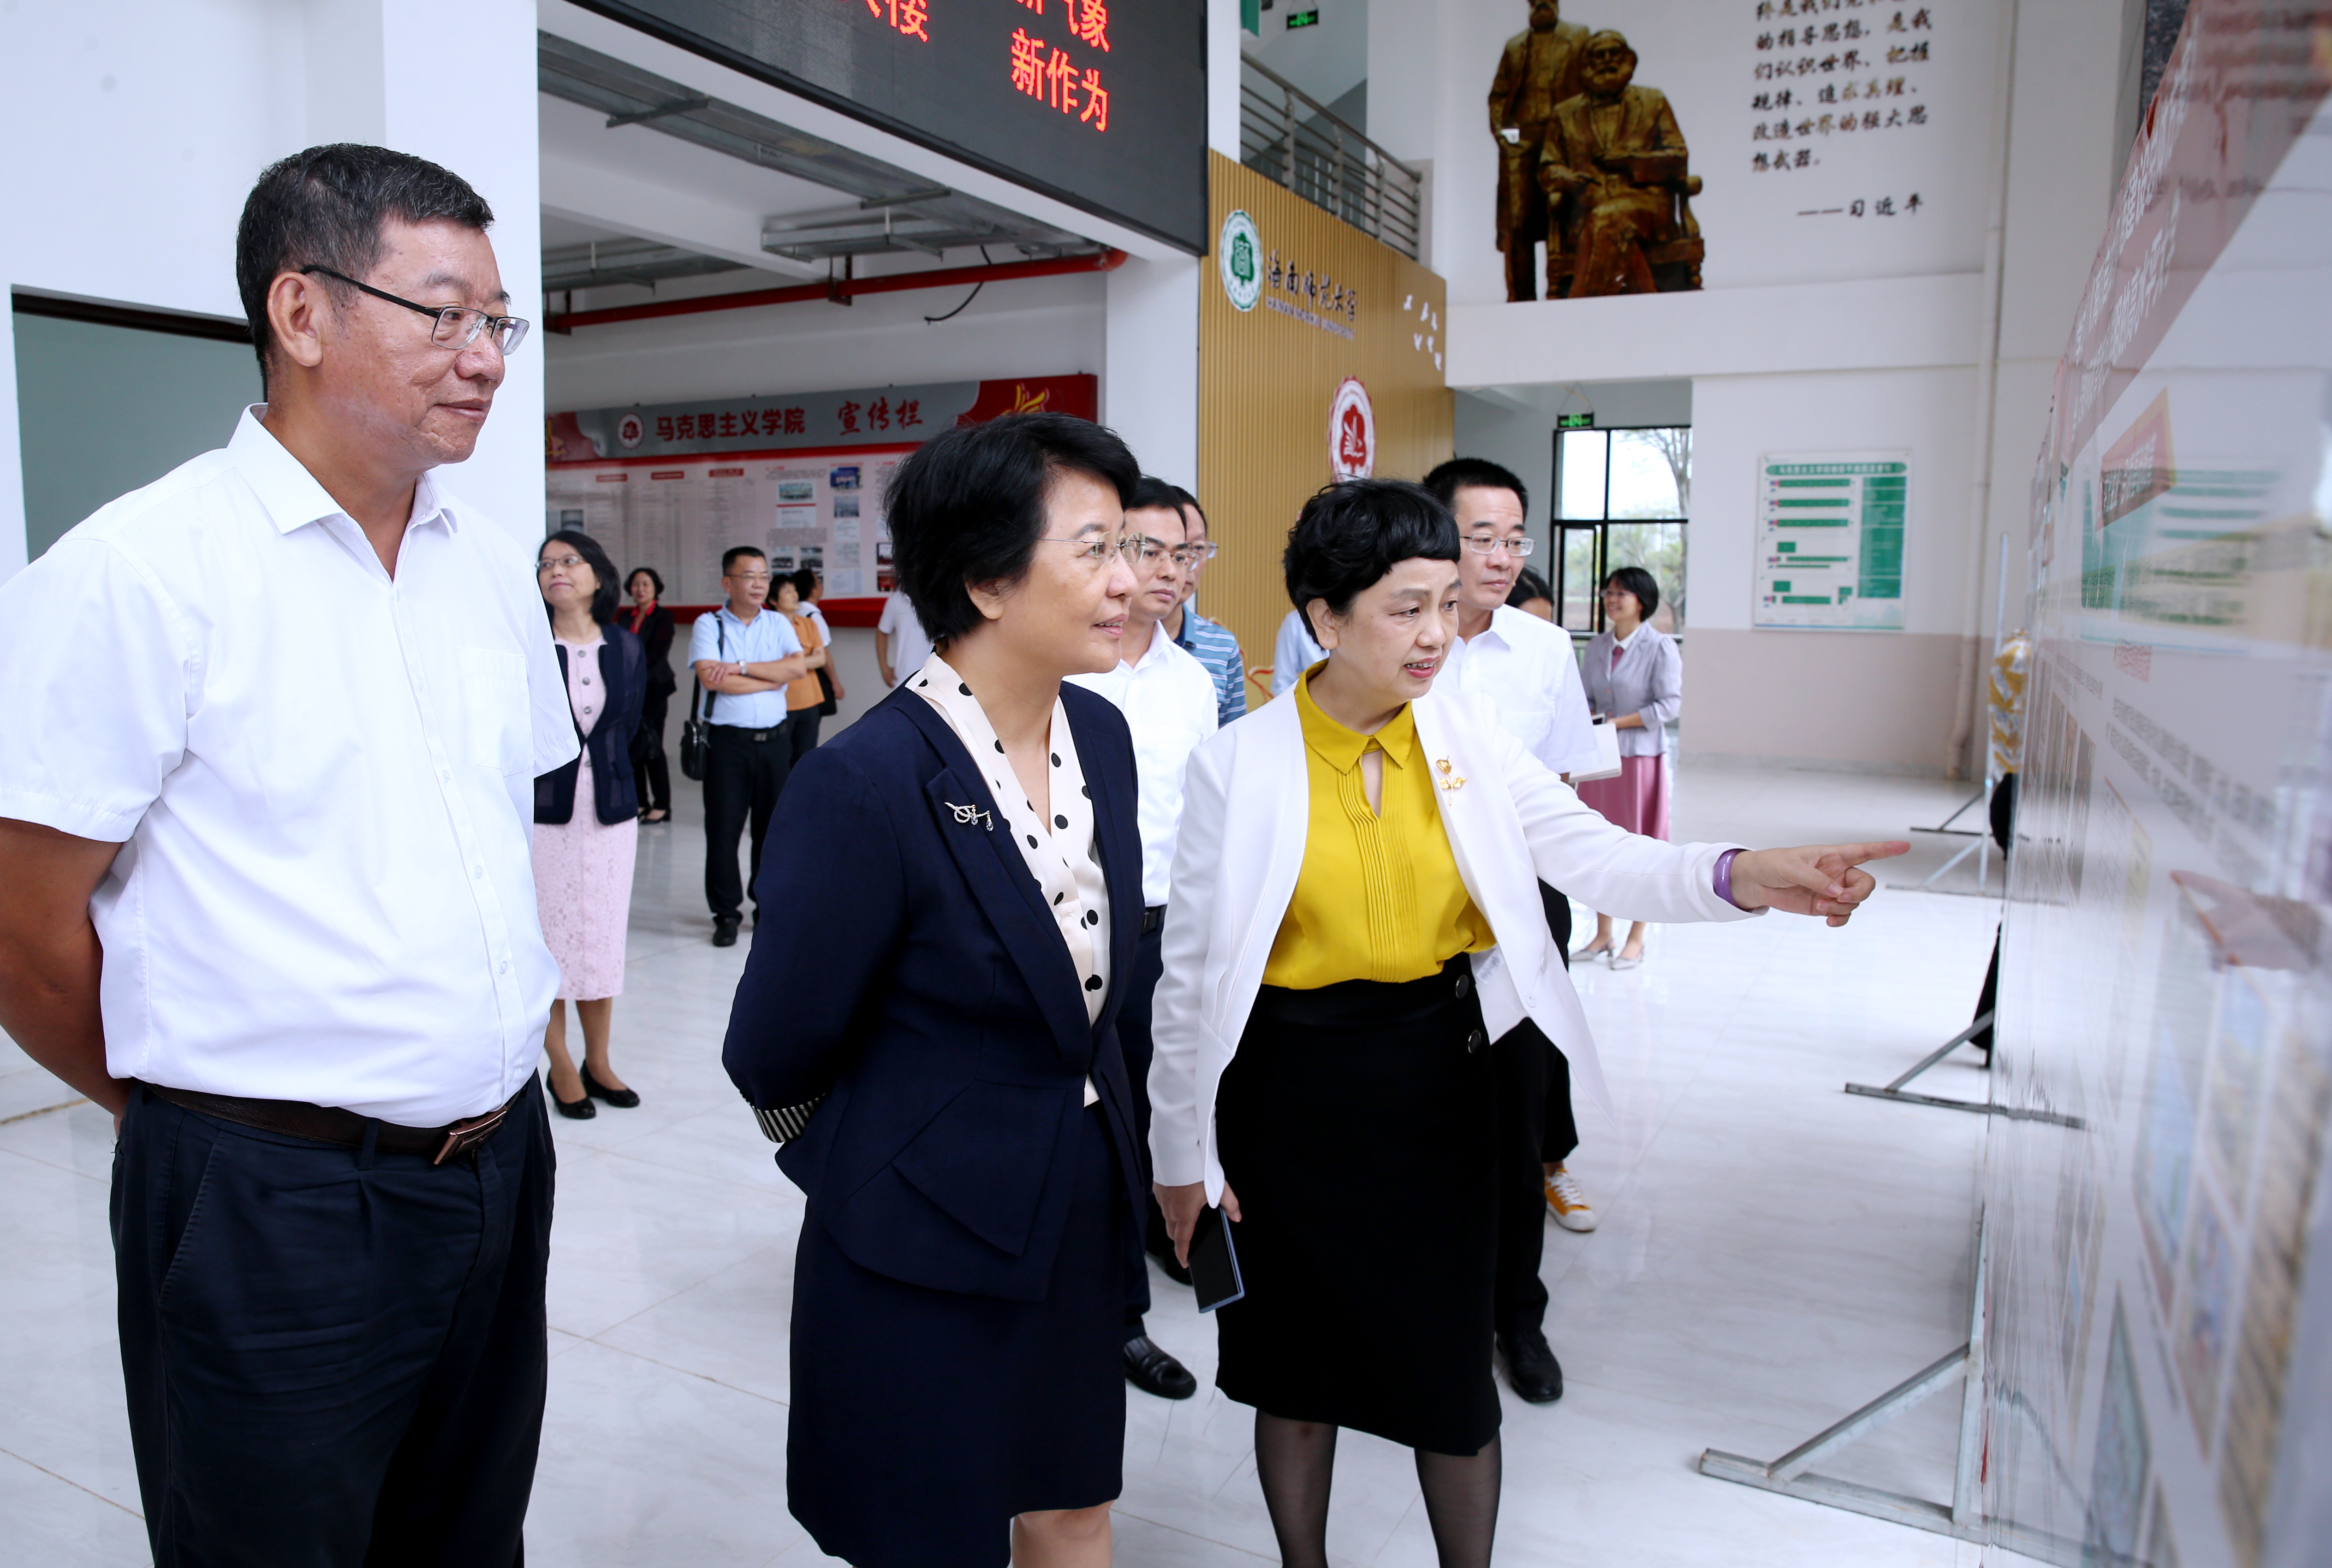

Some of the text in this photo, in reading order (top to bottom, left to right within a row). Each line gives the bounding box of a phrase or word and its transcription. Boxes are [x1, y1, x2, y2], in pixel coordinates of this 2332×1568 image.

[1011, 28, 1108, 132] 新作为
[655, 397, 923, 441] 马克思主义学院 宣传栏
